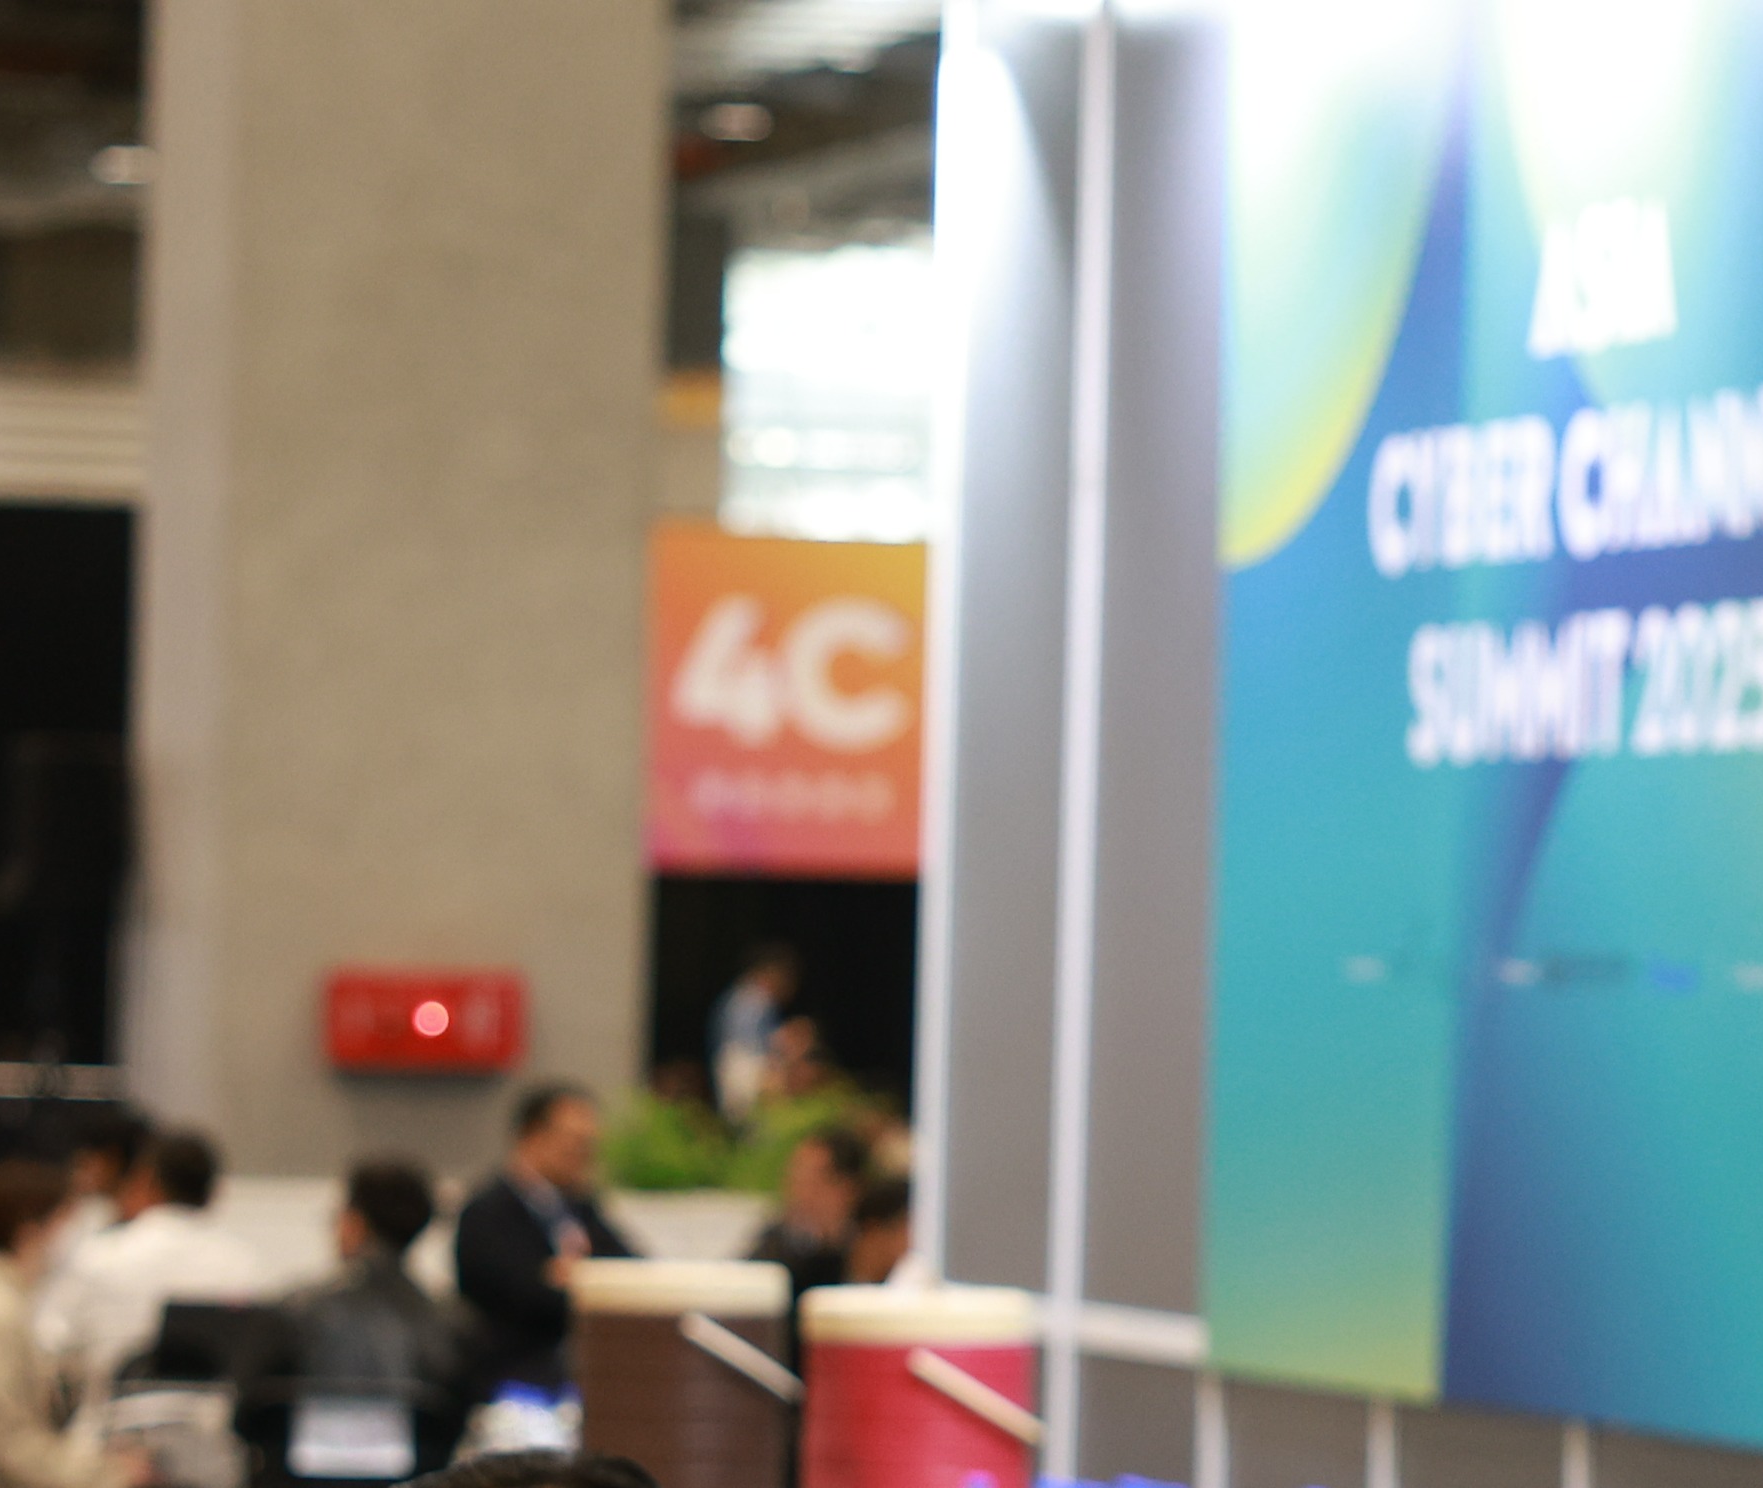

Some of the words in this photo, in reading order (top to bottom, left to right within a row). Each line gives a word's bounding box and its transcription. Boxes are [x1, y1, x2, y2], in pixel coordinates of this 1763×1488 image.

[1368, 414, 1556, 578] CYBER
[673, 593, 912, 752] 4C
[1408, 606, 1631, 768] SUMMIT
